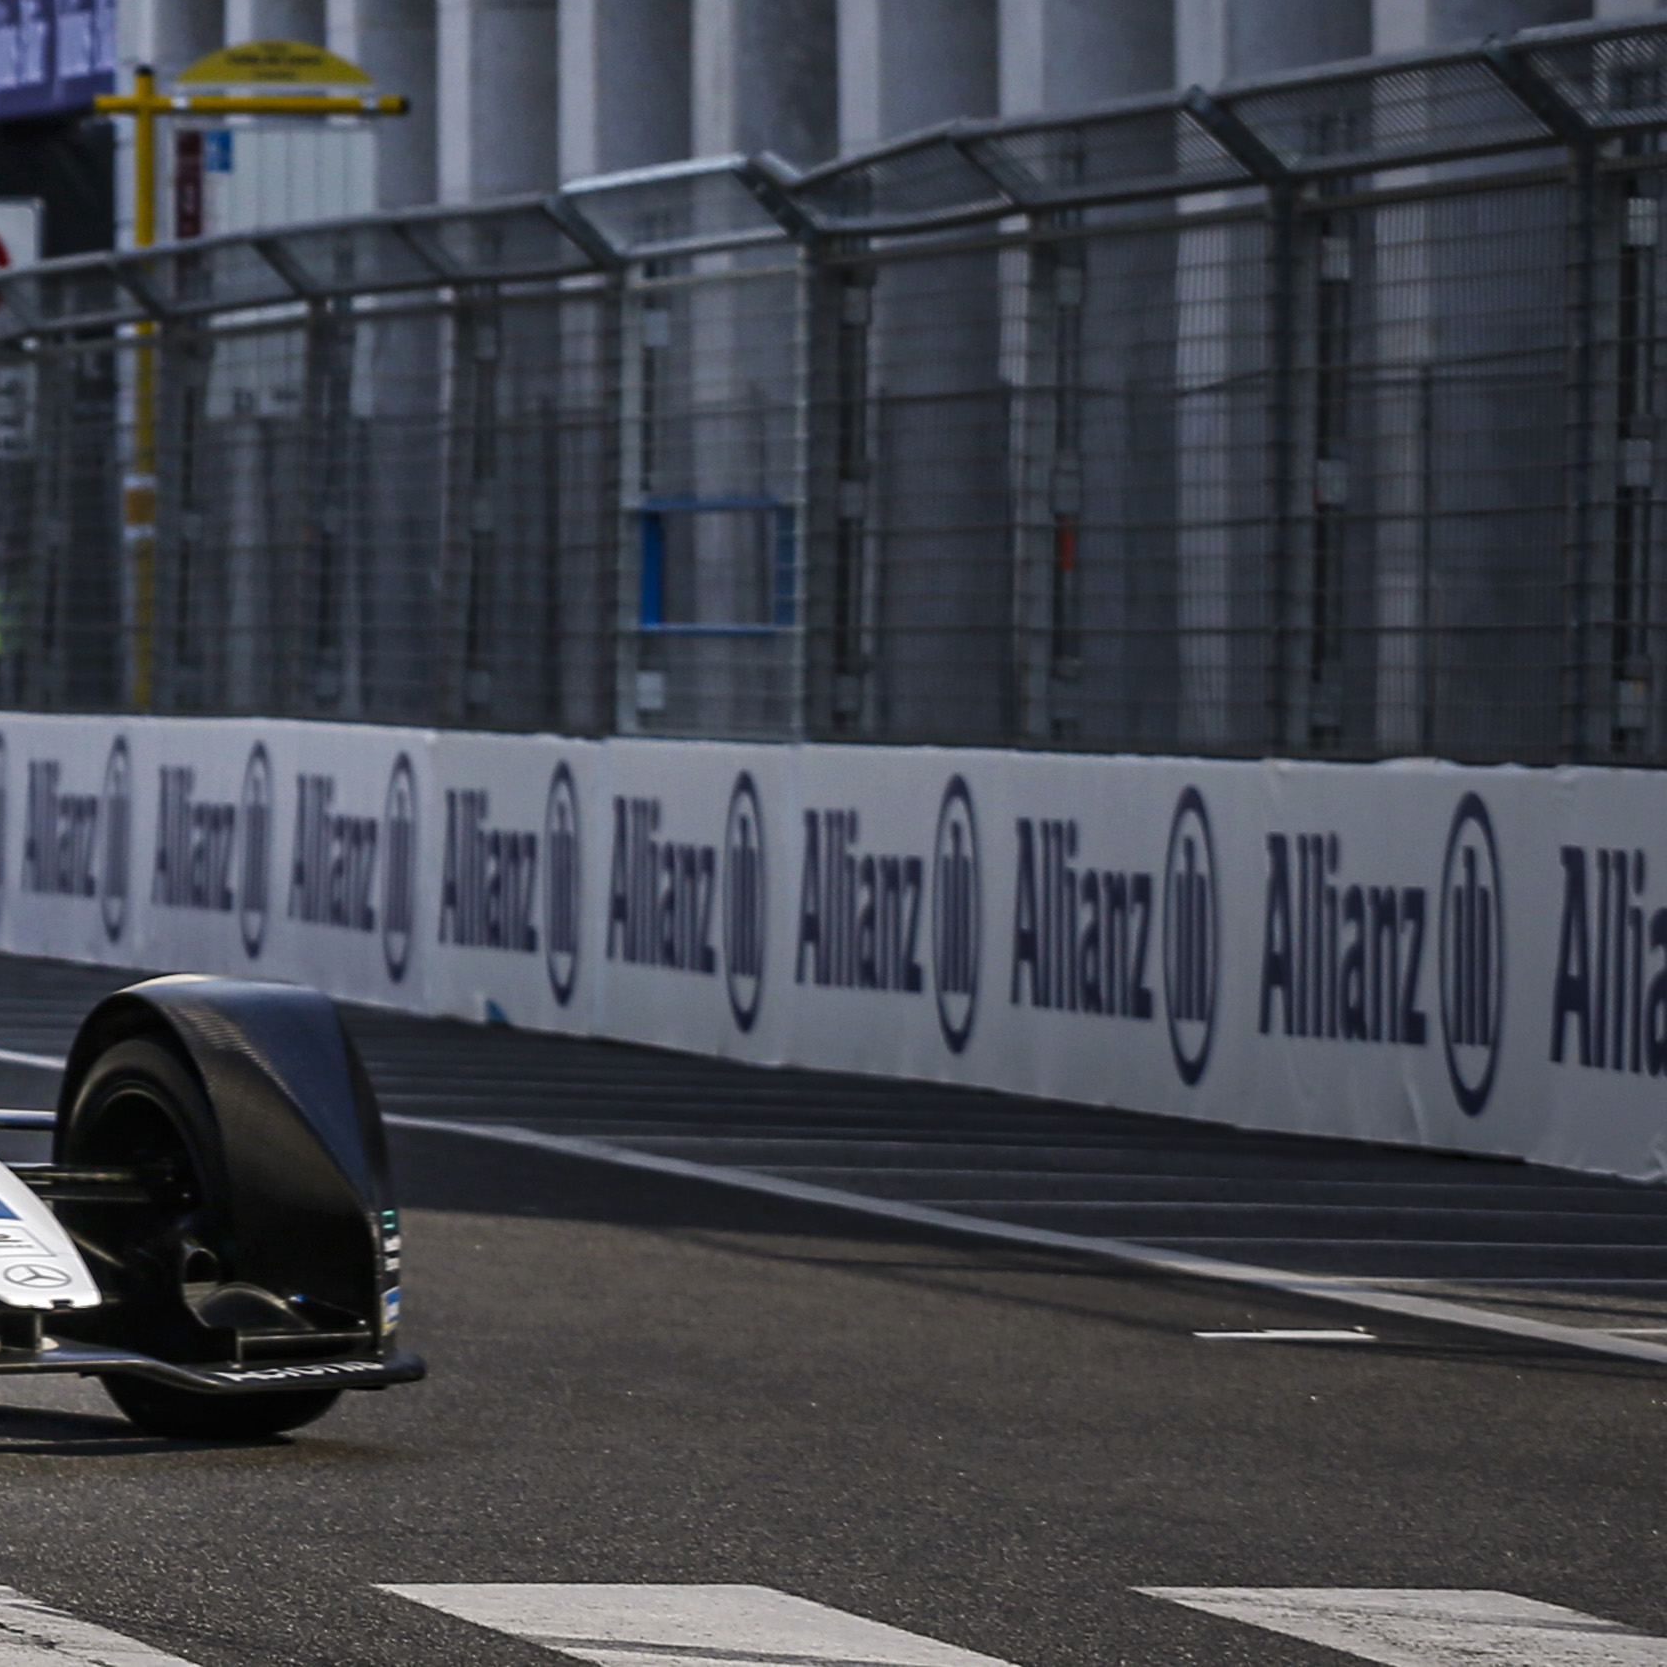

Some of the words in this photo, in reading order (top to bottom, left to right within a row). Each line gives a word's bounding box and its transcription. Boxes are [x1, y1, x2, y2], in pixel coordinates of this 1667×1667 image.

[437, 788, 539, 954] Allianz
[605, 795, 717, 976] Allianz
[794, 807, 924, 994] Allianz
[1010, 816, 1155, 1021] Allianz
[1257, 831, 1428, 1046] Allianz
[1548, 844, 1667, 1078] Allia
